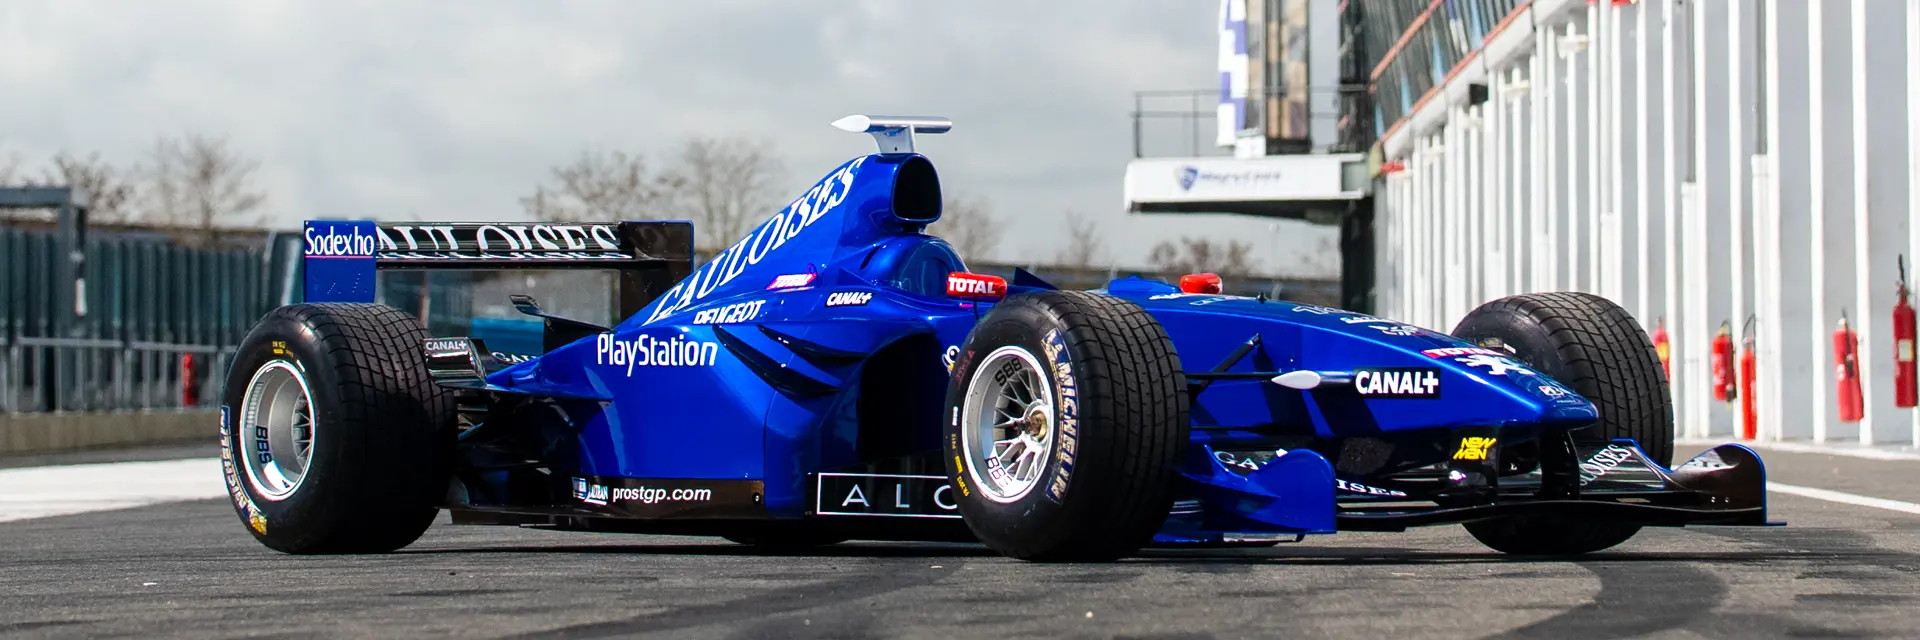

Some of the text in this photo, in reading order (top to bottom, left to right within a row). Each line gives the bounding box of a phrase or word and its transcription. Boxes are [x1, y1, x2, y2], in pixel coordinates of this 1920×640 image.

[641, 156, 867, 327] GAULOISES
[948, 277, 996, 294] TOTAL
[826, 292, 873, 306] CANAL+
[425, 341, 468, 351] CANAL+
[597, 333, 718, 377] PlayStation
[1354, 371, 1439, 394] CANAL+
[1050, 362, 1078, 500] MICHELIN
[255, 425, 273, 465] BBS
[613, 485, 712, 504] prostgp.com
